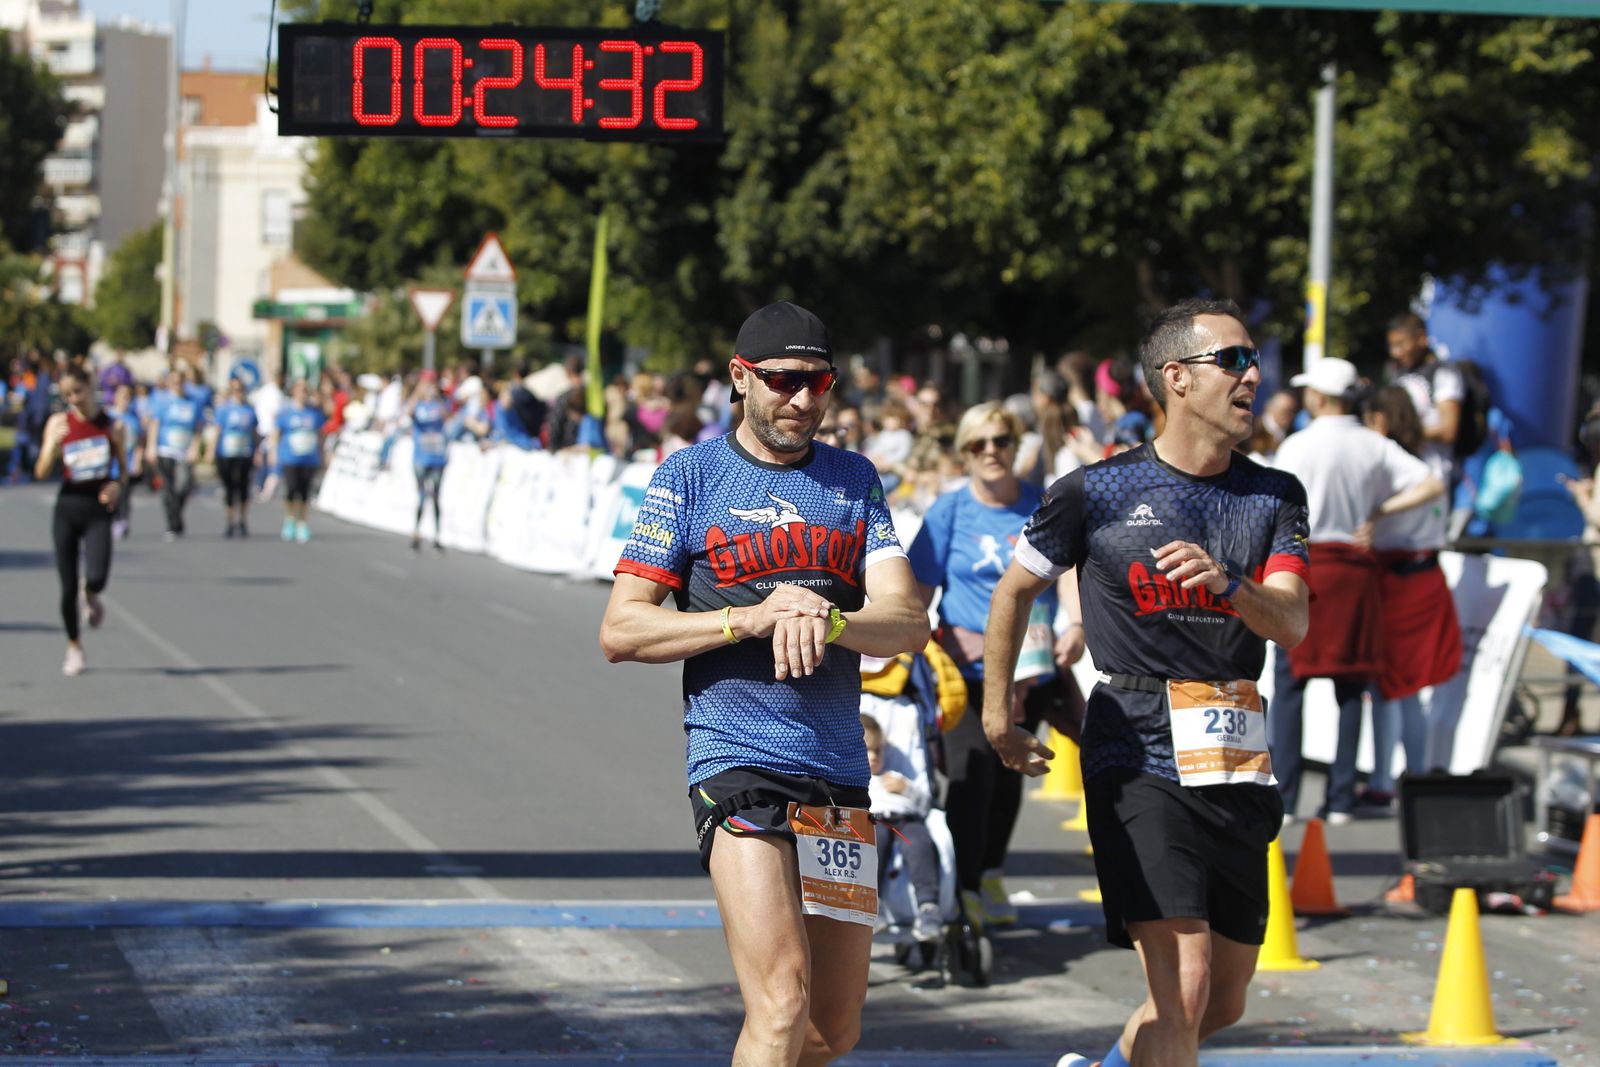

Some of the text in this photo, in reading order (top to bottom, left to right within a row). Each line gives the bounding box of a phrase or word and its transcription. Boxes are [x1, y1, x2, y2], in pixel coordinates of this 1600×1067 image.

[1187, 615, 1226, 624] DEPORTIVO
[1203, 708, 1247, 736] 238
[816, 838, 862, 870] 365
[824, 867, 857, 879] ALEX R.S.
